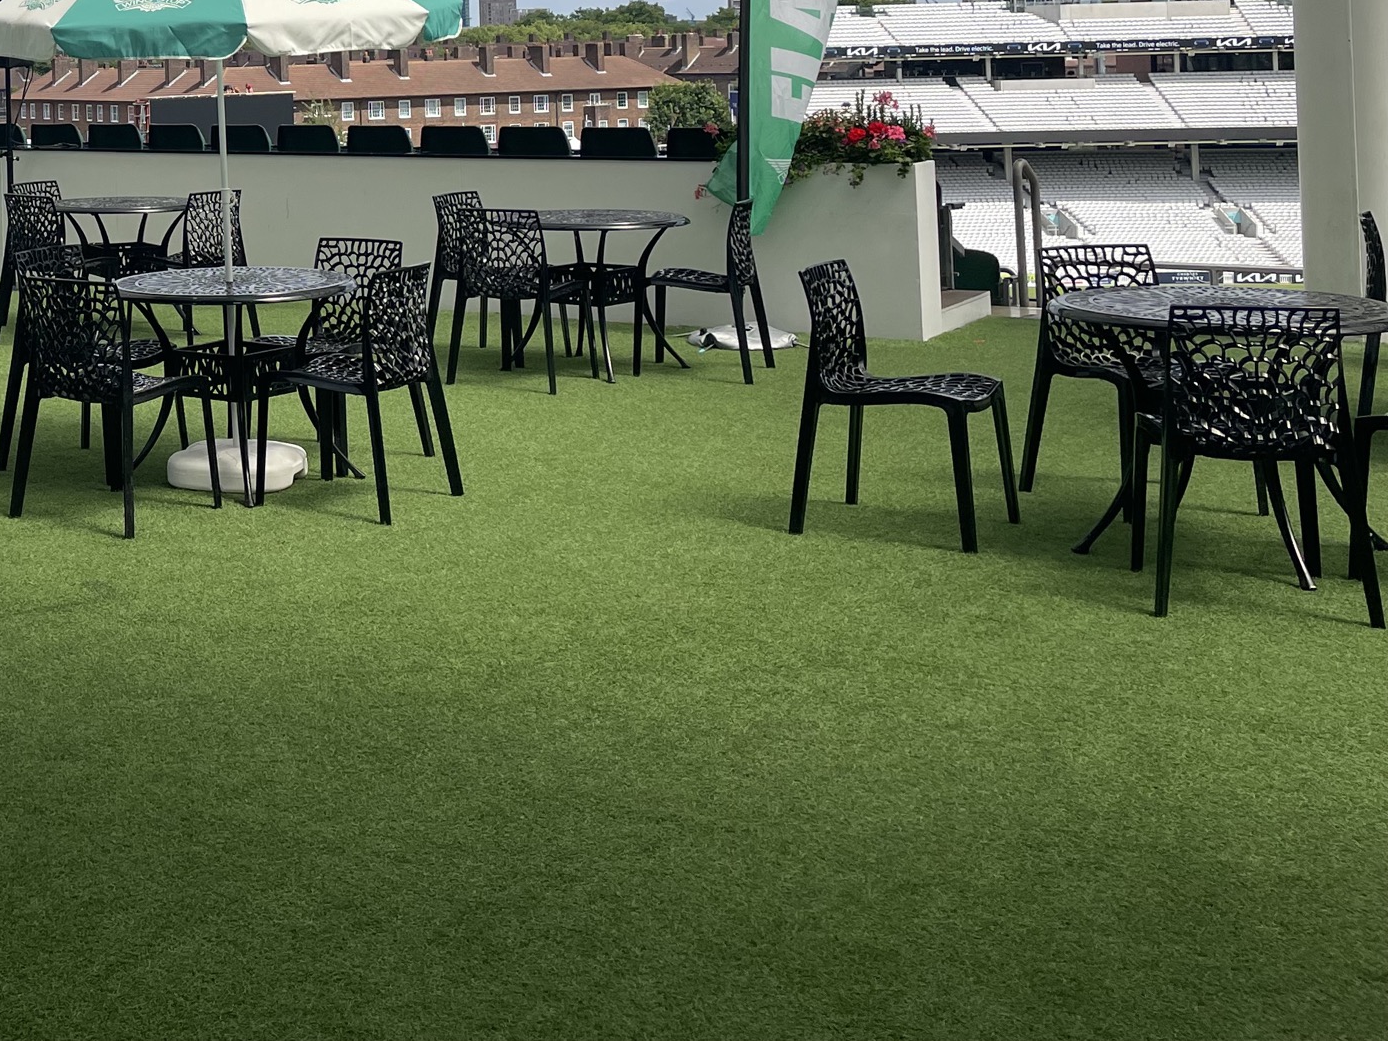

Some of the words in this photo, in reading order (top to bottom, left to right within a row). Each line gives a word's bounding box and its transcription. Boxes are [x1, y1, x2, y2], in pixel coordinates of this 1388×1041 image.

[1155, 40, 1180, 48] electric.
[1216, 37, 1252, 47] KIA
[847, 47, 878, 56] KIA
[940, 45, 954, 53] lead.
[1027, 42, 1061, 52] KIA
[1237, 272, 1277, 283] KIA
